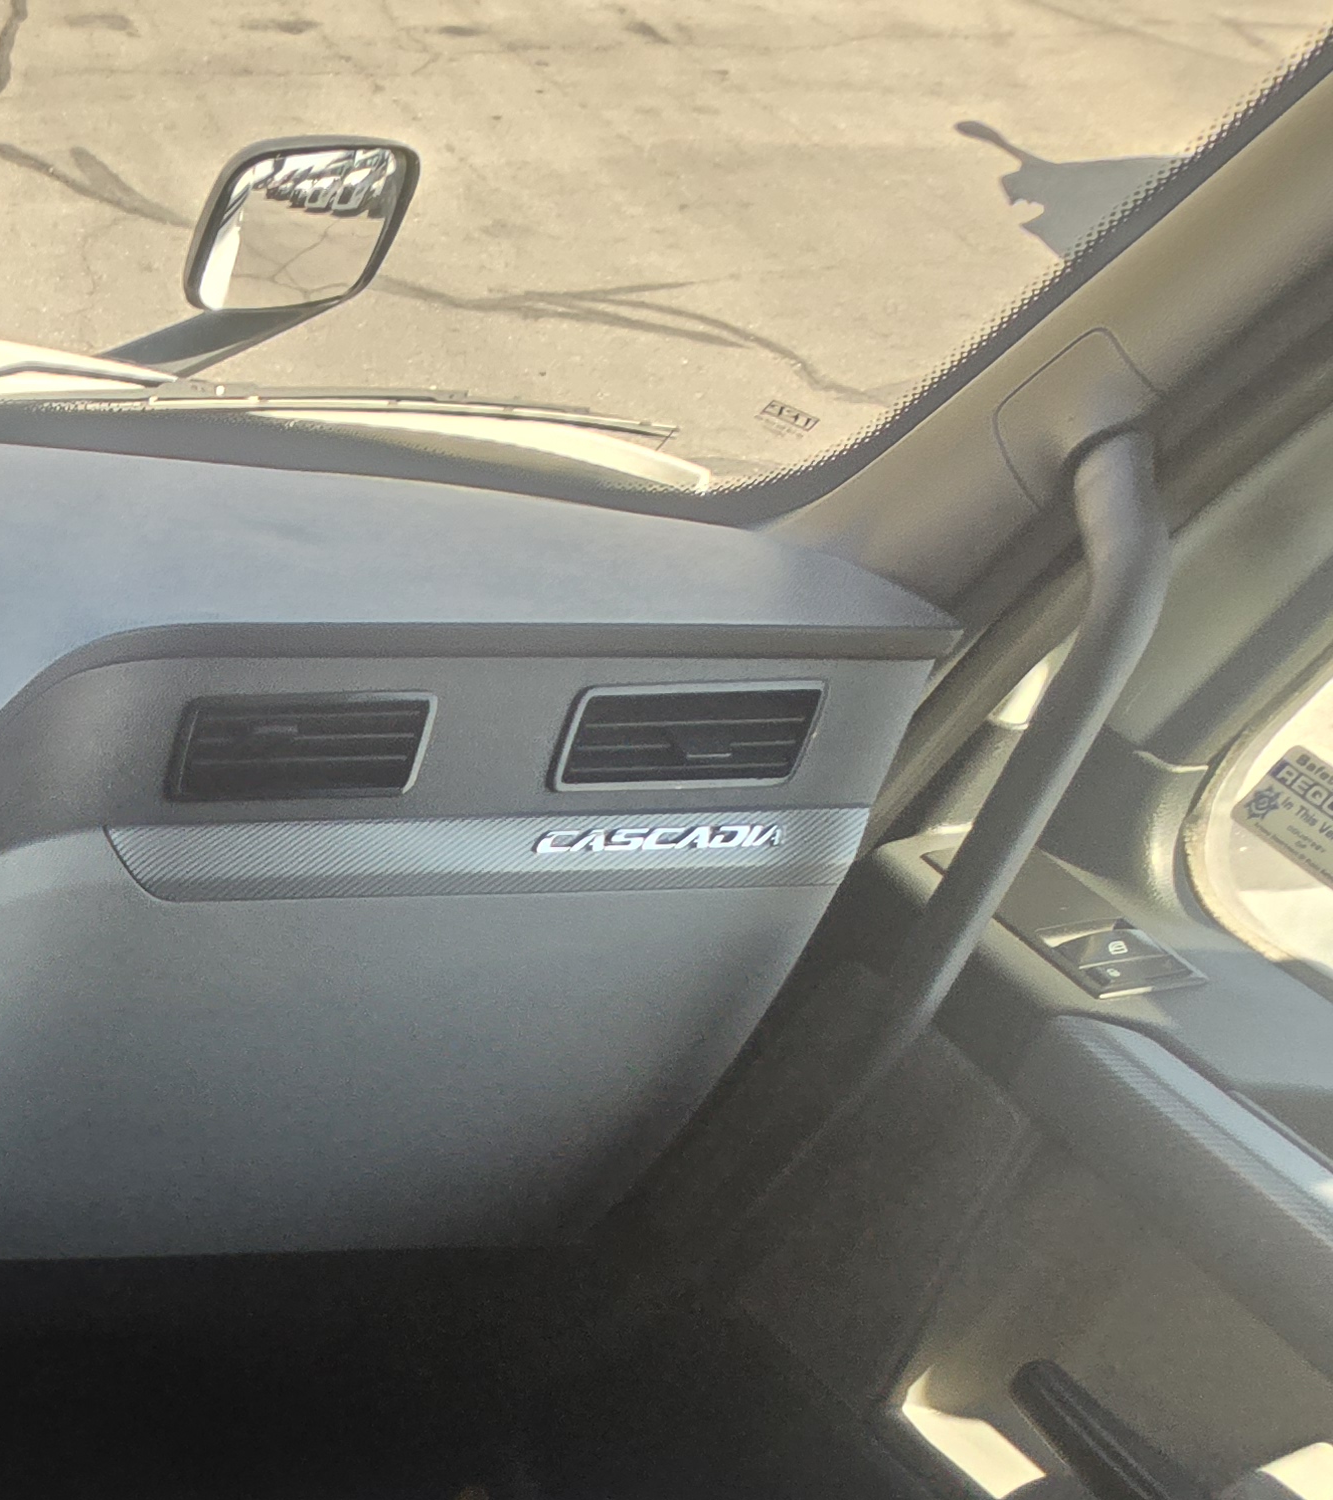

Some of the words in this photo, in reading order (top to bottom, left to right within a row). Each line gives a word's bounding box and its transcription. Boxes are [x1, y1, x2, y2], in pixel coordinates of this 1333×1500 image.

[1281, 797, 1294, 811] In
[1295, 805, 1318, 827] This
[535, 825, 784, 854] CASCADIA
